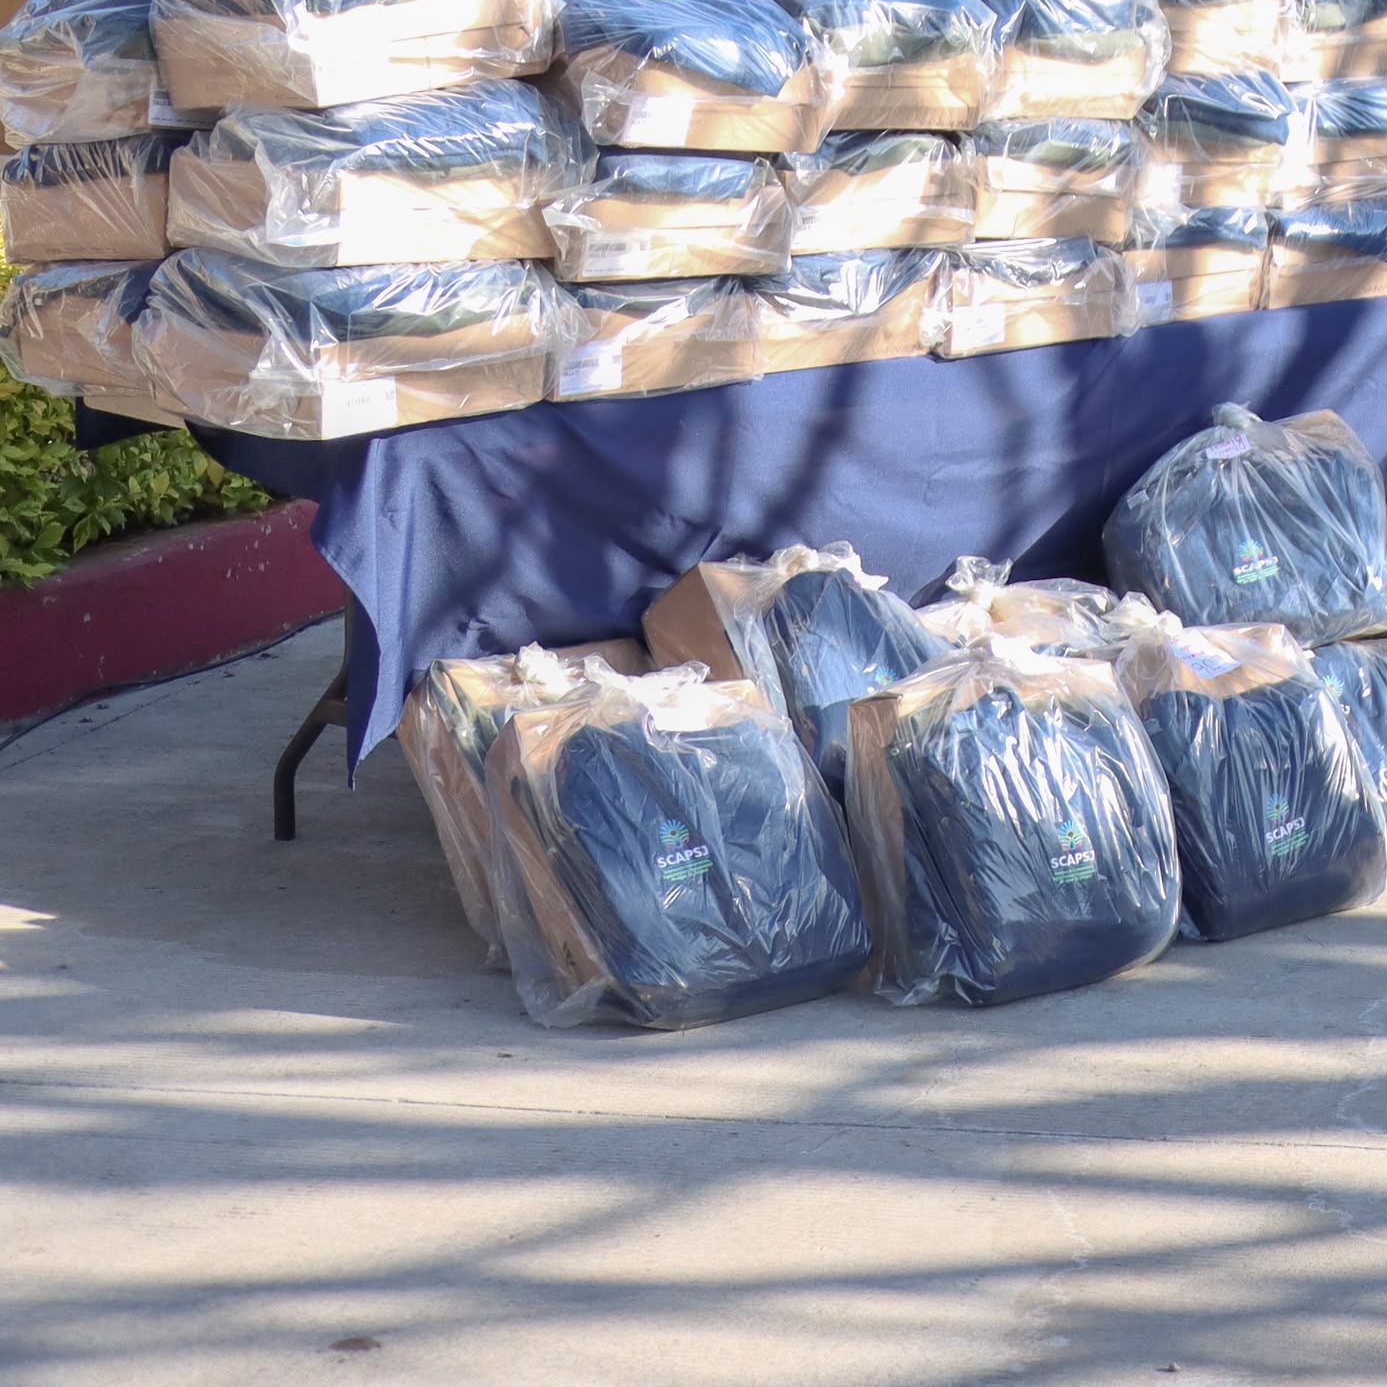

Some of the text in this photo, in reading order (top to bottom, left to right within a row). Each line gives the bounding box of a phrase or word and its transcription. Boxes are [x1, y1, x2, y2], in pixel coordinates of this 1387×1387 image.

[1265, 817, 1305, 843] SCAPSJ
[657, 845, 709, 869] SCAPSJ
[1051, 850, 1095, 869] SCAPSJ
